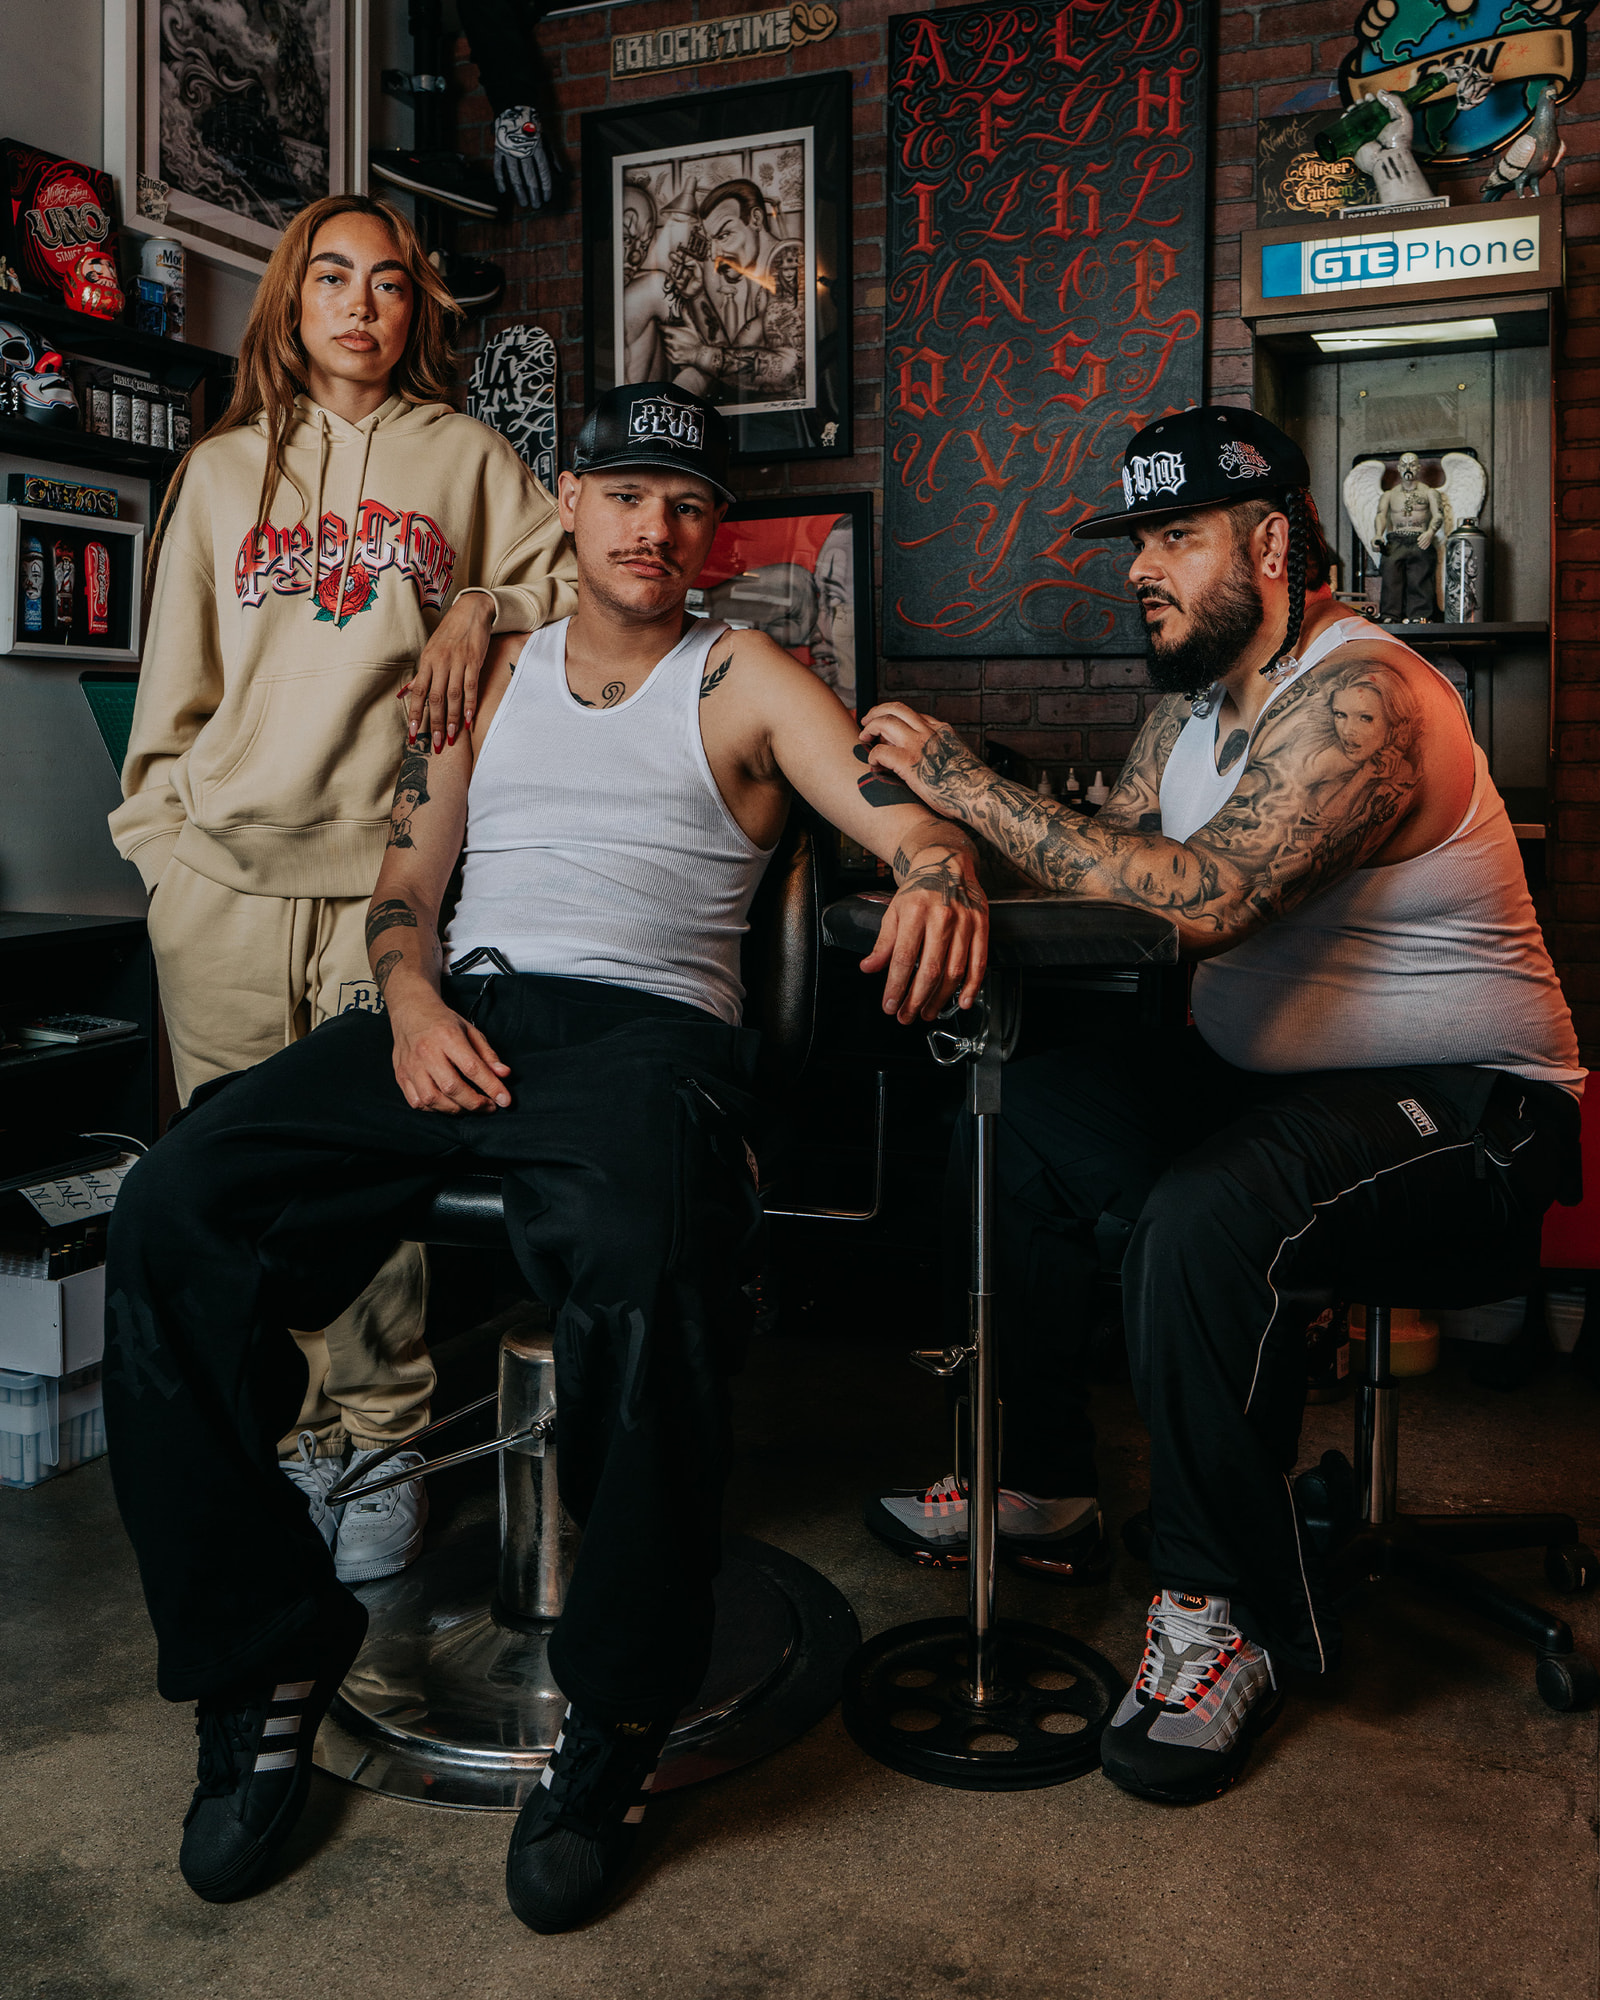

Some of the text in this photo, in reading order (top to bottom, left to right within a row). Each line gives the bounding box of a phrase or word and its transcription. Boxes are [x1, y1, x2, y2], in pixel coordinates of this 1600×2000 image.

[626, 25, 709, 68] BLOCK
[721, 10, 791, 54] TIME
[890, 18, 960, 91] A
[25, 202, 110, 250] UNO
[1315, 237, 1535, 279] GTE Phone
[632, 414, 700, 444] CLUB
[641, 404, 696, 428] PRO
